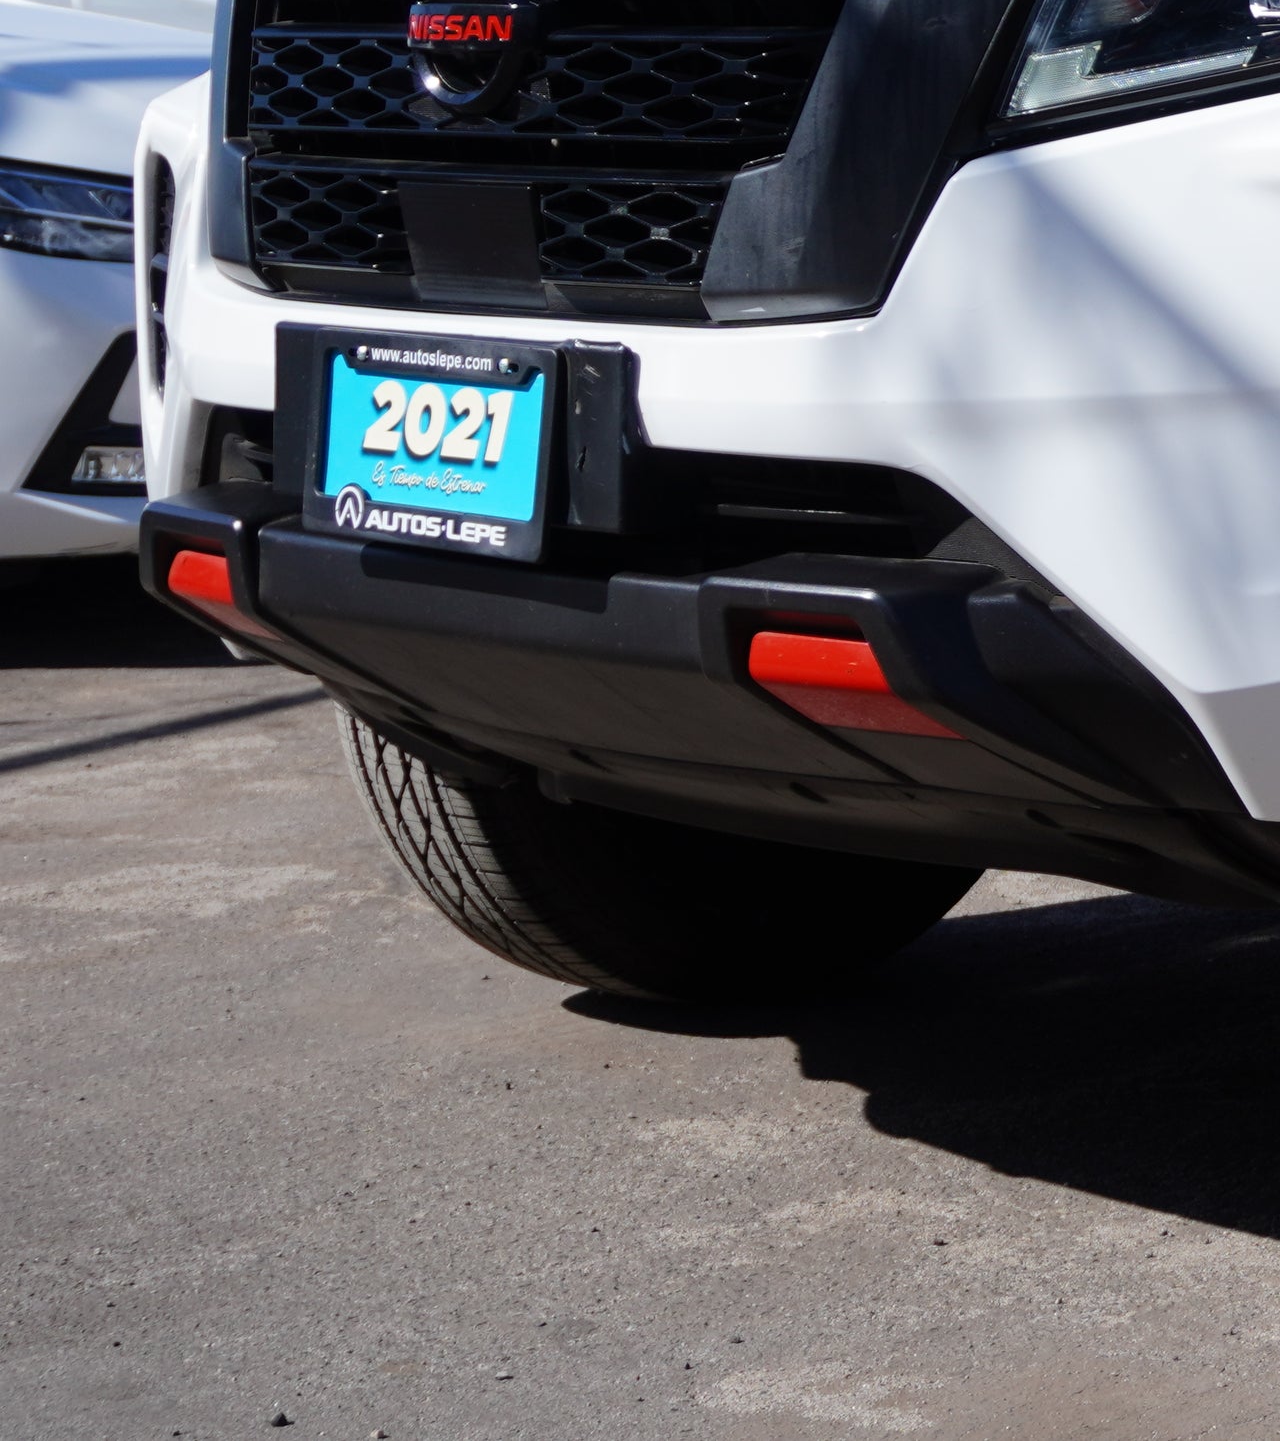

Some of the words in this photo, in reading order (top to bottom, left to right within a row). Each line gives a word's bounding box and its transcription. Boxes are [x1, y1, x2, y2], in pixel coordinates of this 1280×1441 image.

[408, 13, 513, 42] NISSAN
[371, 347, 492, 371] www.autoslepe.com
[363, 380, 515, 464] 2021
[372, 461, 386, 487] Es
[389, 464, 423, 490] Tiempo
[426, 470, 440, 489] de
[440, 468, 486, 494] Estrenar
